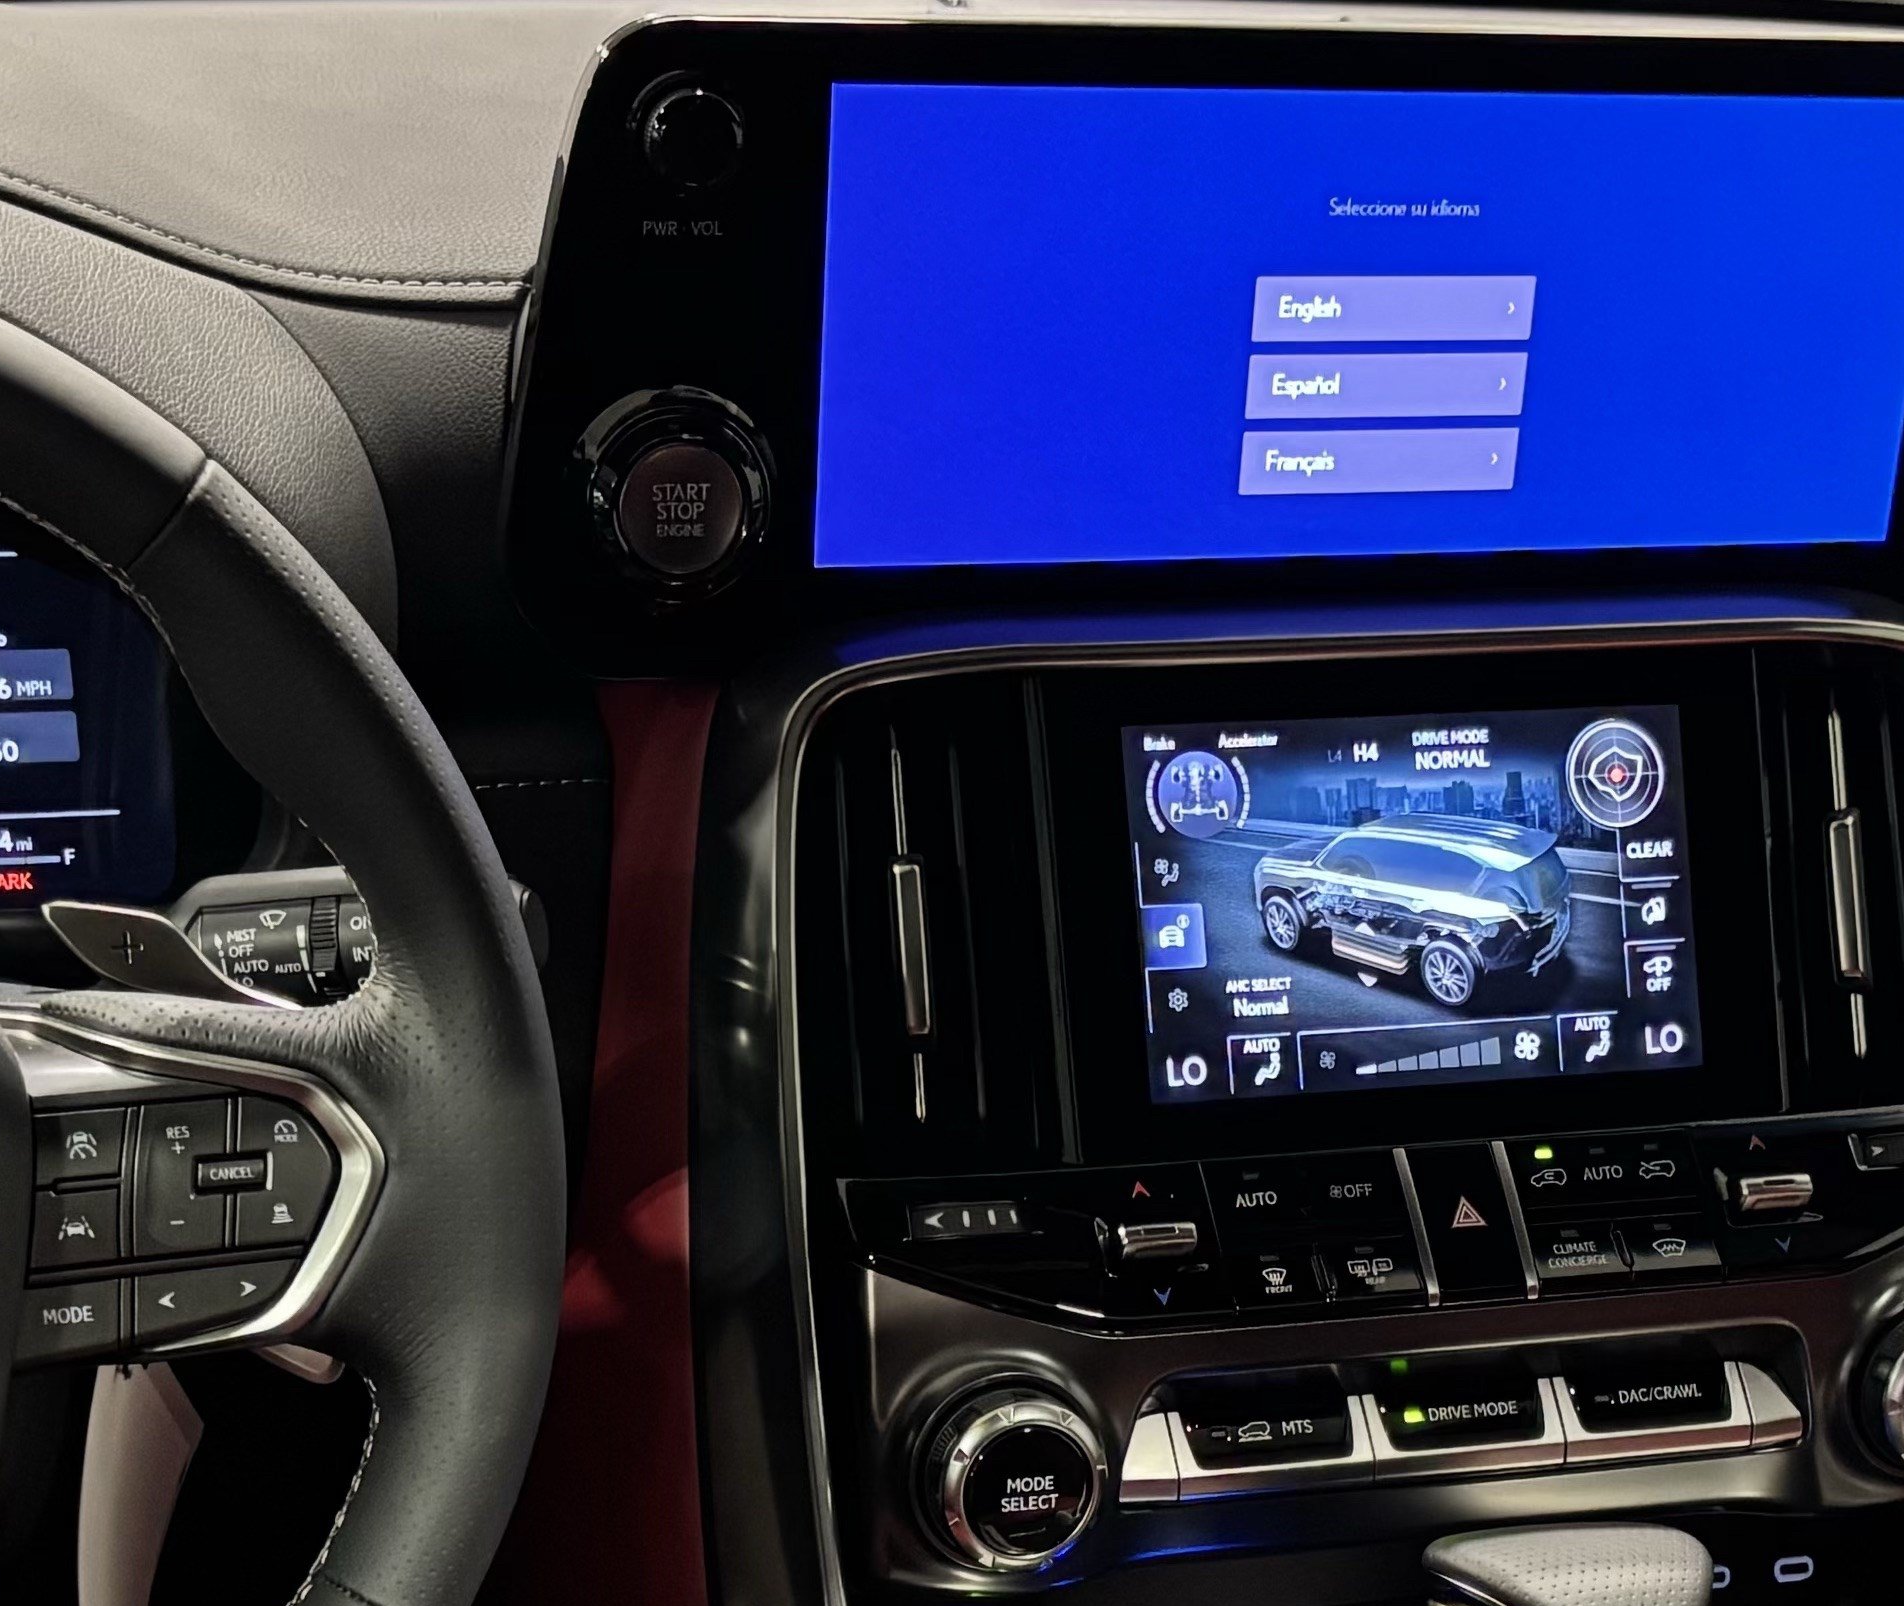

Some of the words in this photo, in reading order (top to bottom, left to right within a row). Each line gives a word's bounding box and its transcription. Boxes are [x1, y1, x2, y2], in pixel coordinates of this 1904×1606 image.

[642, 221, 678, 236] PWR
[691, 221, 723, 236] VOL
[1278, 295, 1341, 322] English
[1272, 373, 1340, 399] Español
[1265, 450, 1335, 477] Français
[652, 483, 711, 502] START
[656, 502, 705, 519] STOP
[656, 524, 704, 538] ENGINE
[17, 681, 51, 697] MPH
[1412, 731, 1447, 747] DRIVE
[1450, 729, 1488, 745] MODE
[1353, 743, 1378, 763] H4
[1415, 748, 1490, 770] NORMAL
[16, 837, 33, 852] mi
[1626, 840, 1673, 859] CLEAR
[63, 849, 75, 865] F
[227, 928, 256, 943] MIST
[229, 944, 254, 958] OFF
[234, 960, 269, 974] AUTO
[275, 963, 301, 974] AUTO
[1225, 979, 1252, 995] AHC
[1253, 977, 1291, 992] SELECT
[1646, 978, 1672, 993] OFF
[1233, 995, 1289, 1017] Normal
[1574, 1015, 1610, 1032] AUTO
[1243, 1038, 1281, 1055] AUTO
[1644, 1024, 1683, 1056] LO
[1166, 1056, 1207, 1089] LO
[166, 1126, 190, 1139] RES
[210, 1167, 254, 1180] CANCEL
[1584, 1165, 1623, 1181] AUTO
[1236, 1191, 1277, 1208] AUTO
[1344, 1184, 1372, 1198] OFF
[1553, 1241, 1597, 1254] CLIMATE
[43, 1306, 94, 1325] MODE
[1619, 1384, 1702, 1404] DAC/CRAWL
[1428, 1404, 1471, 1422] DRIVE
[1474, 1401, 1518, 1419] MODE
[1281, 1420, 1313, 1435] MTS
[1007, 1476, 1054, 1492] MODE
[1001, 1494, 1058, 1513] SELECT
